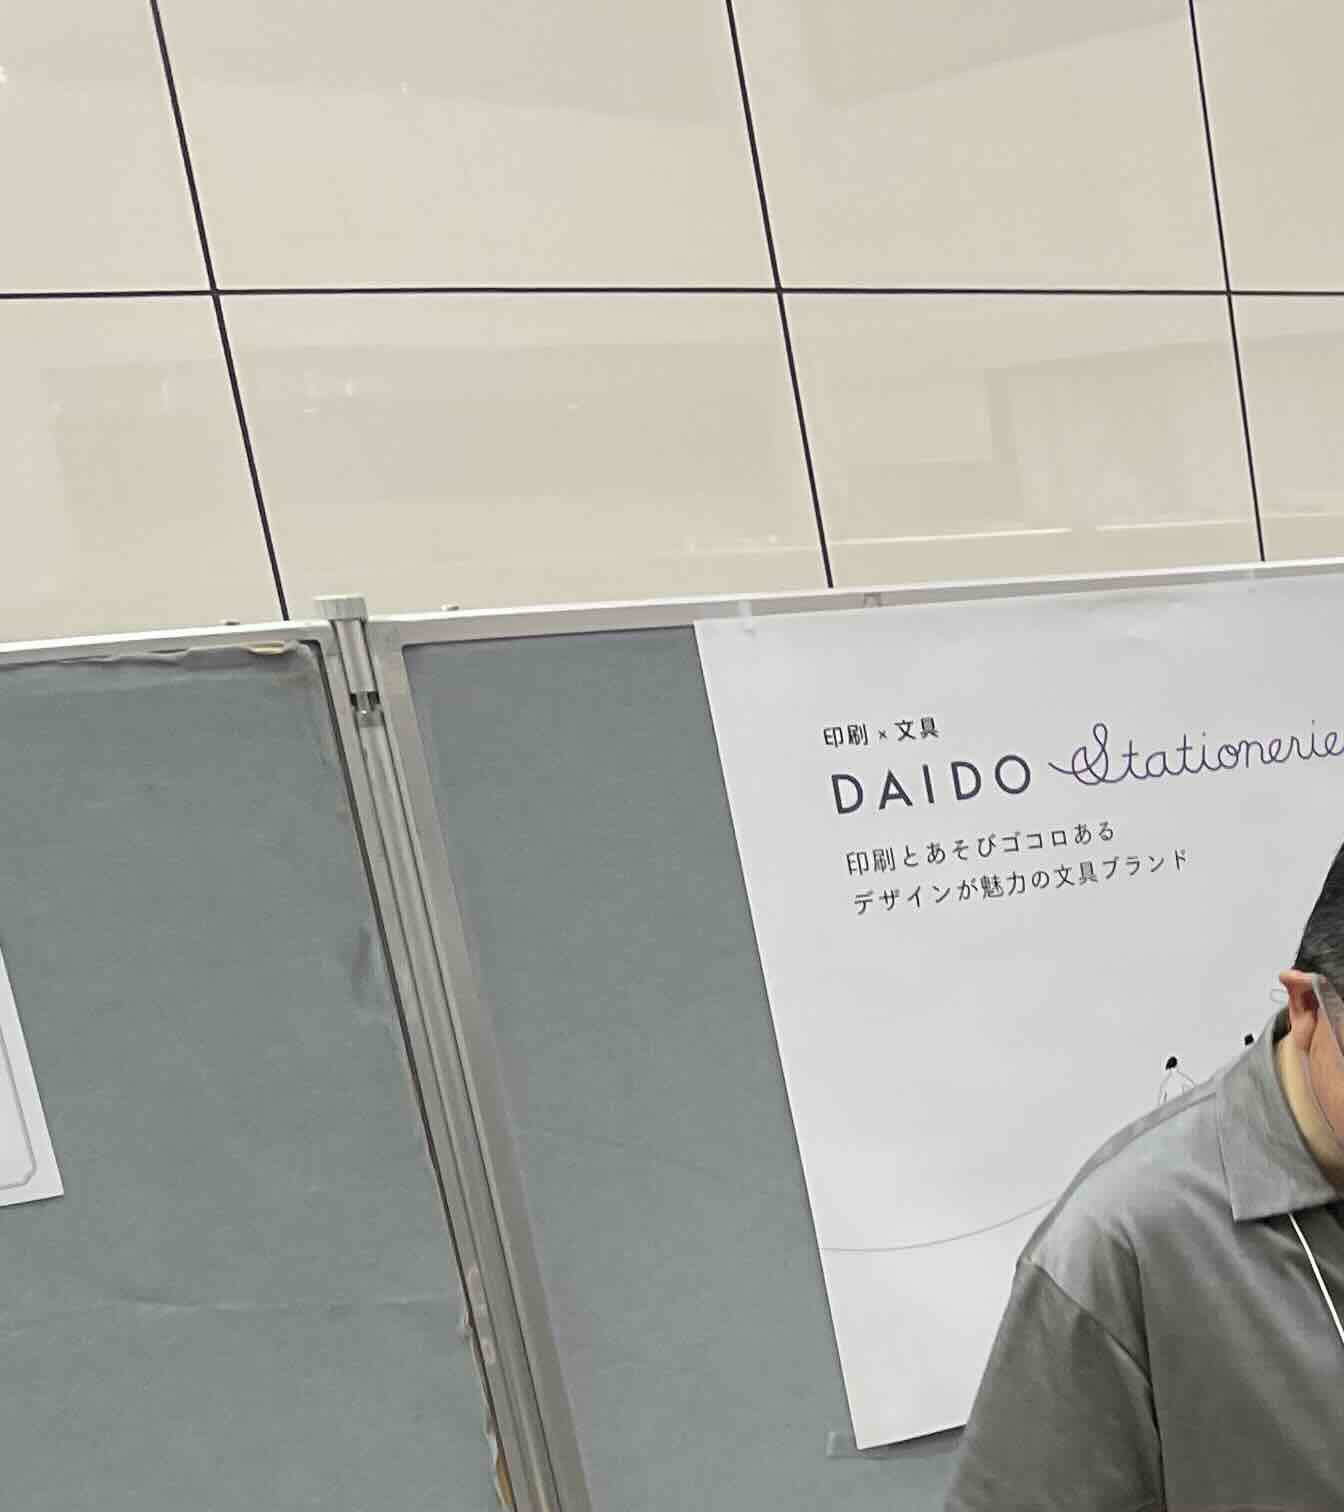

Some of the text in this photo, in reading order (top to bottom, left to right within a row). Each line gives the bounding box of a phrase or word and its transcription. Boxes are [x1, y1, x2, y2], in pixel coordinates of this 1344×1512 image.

[822, 722, 869, 749] 印刷
[894, 716, 940, 742] 文具
[830, 754, 1033, 815] DAIDO
[845, 821, 1115, 878] 印刷とあそびゴコロある
[853, 848, 1189, 915] デザインが魅力の文具ブランド
